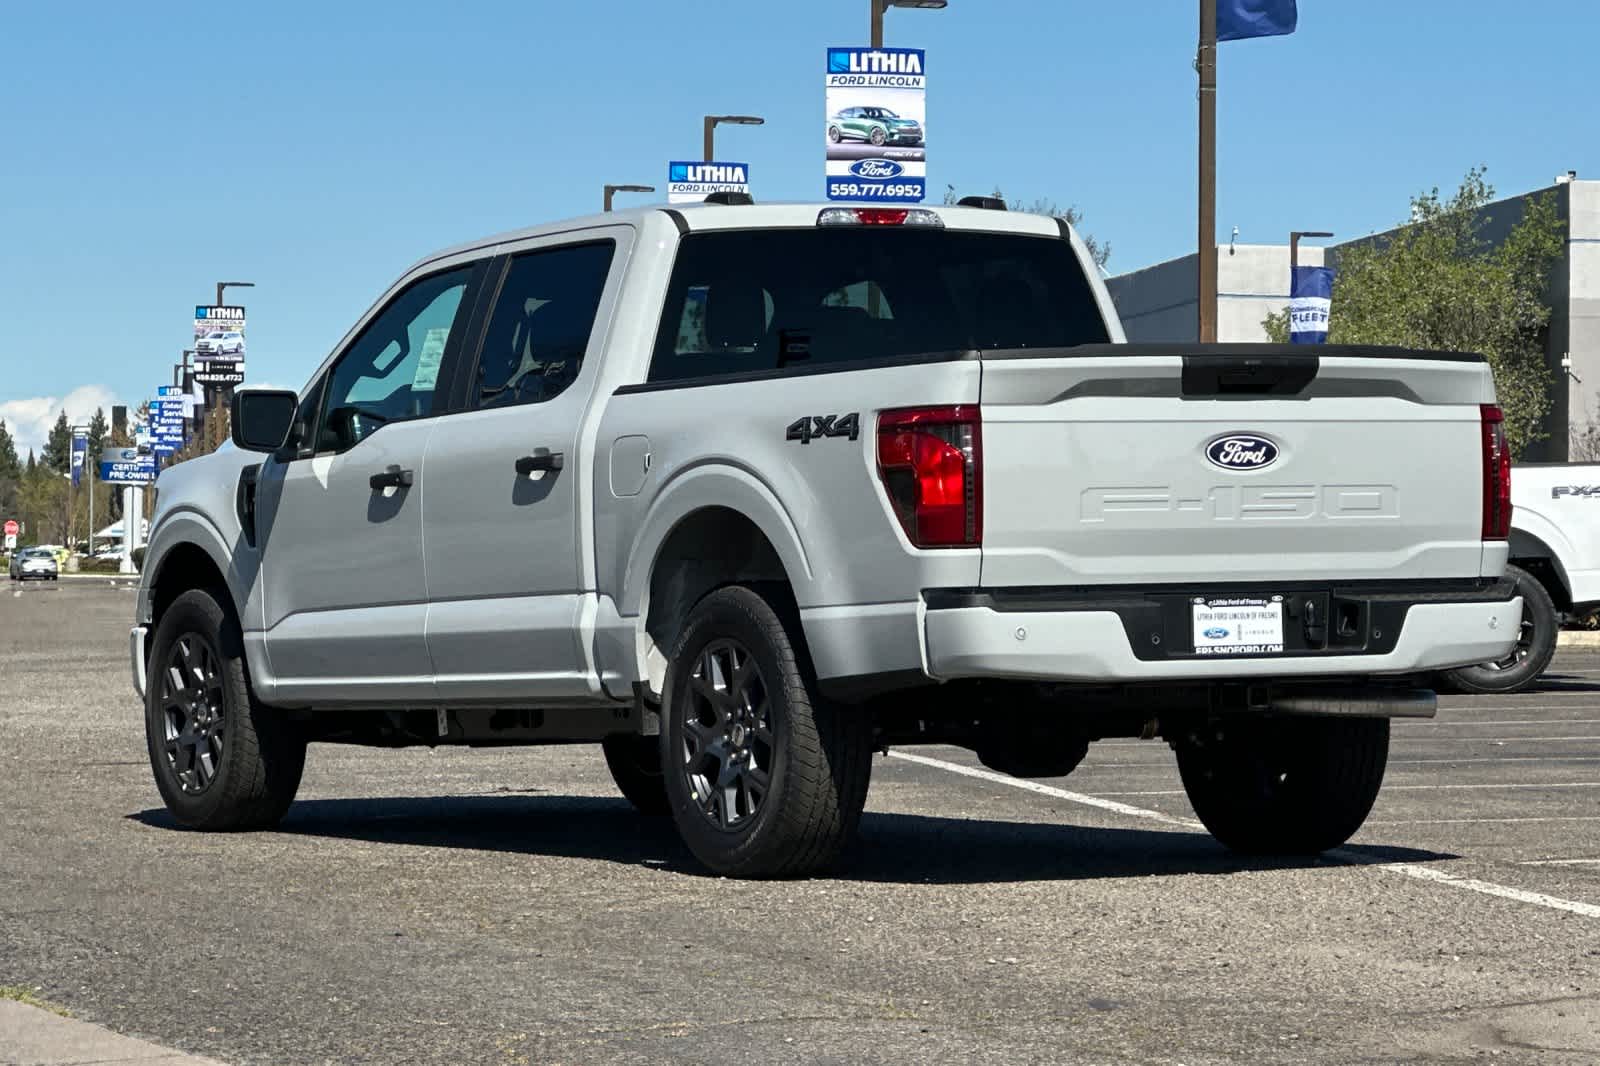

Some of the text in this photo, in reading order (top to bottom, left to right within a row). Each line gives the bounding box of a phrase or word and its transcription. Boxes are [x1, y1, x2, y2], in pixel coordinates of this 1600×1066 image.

[850, 51, 921, 73] LITHIA
[831, 75, 921, 87] FORD LINCOLN
[688, 165, 746, 182] LITHIA
[859, 160, 894, 176] Ford
[672, 184, 745, 193] FORD LINCOLN
[830, 184, 922, 197] 559.777.6952
[206, 308, 244, 319] LITHIA
[1292, 313, 1328, 323] FLEET
[1219, 440, 1267, 464] Ford
[1080, 484, 1400, 523] F-150
[1214, 612, 1228, 620] FORD
[1229, 612, 1250, 620] LINCOLN
